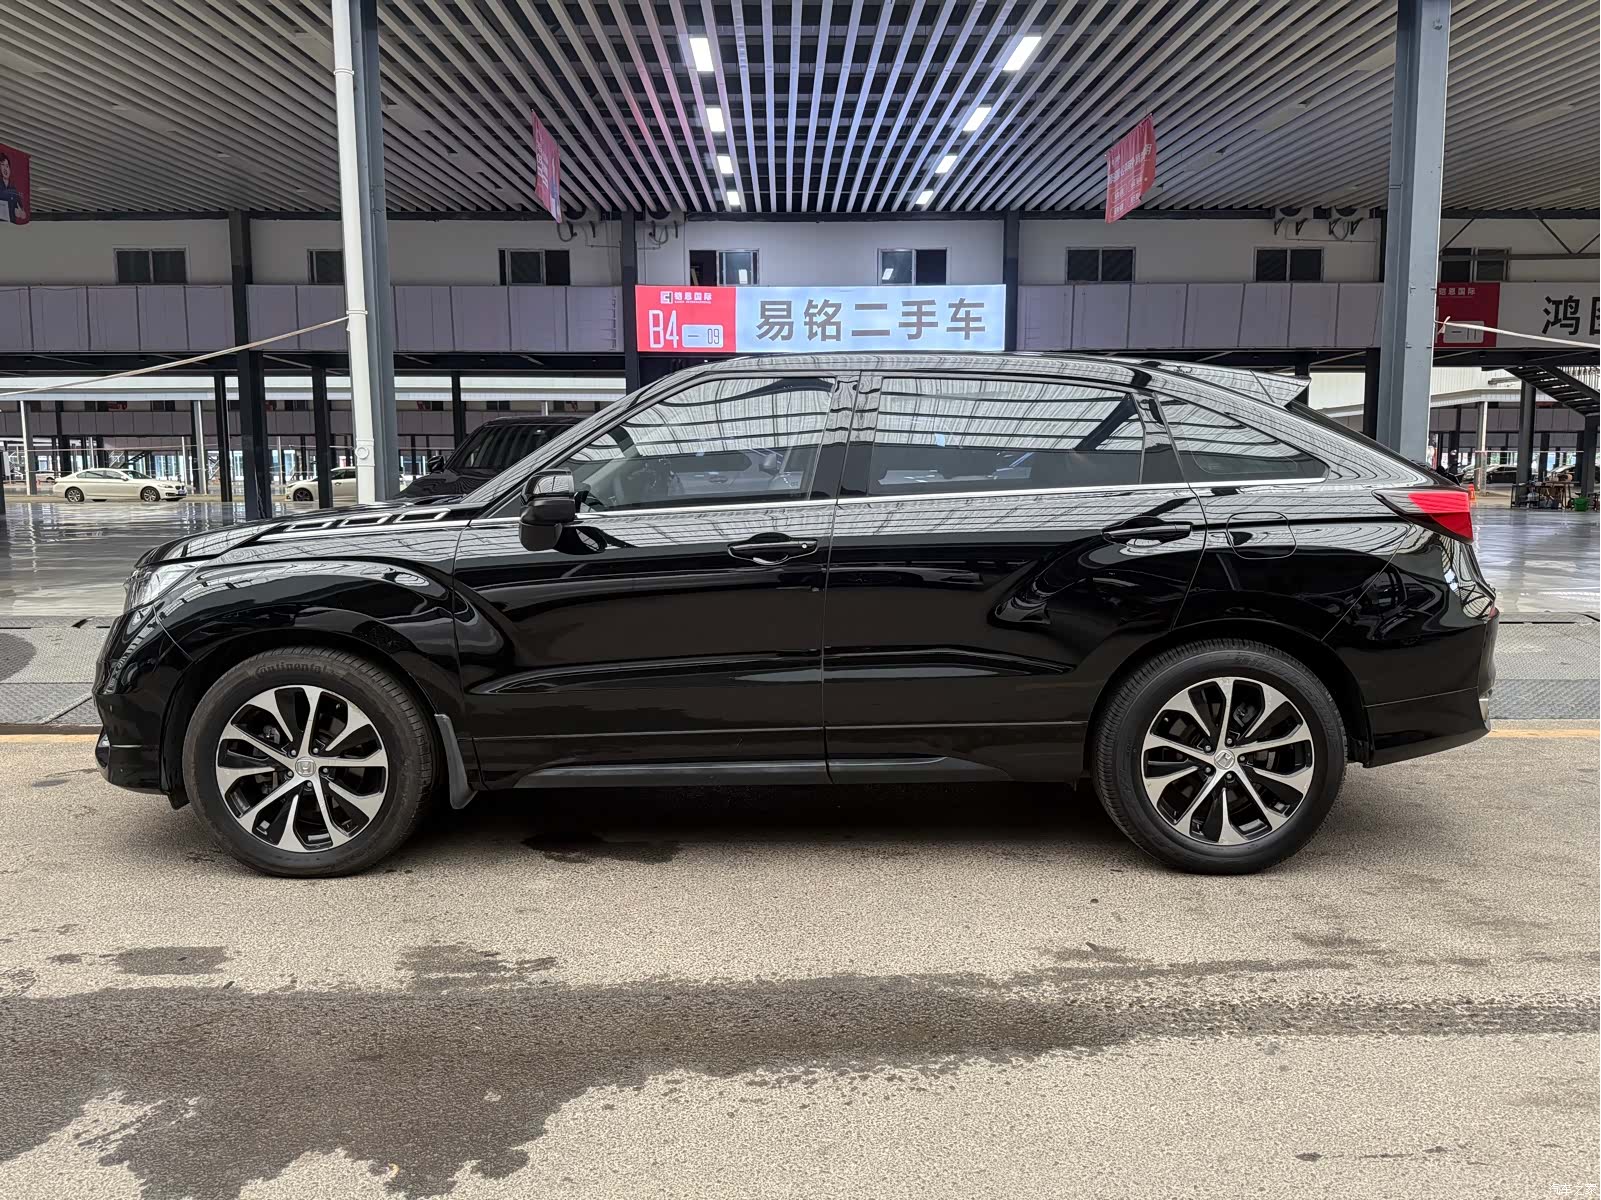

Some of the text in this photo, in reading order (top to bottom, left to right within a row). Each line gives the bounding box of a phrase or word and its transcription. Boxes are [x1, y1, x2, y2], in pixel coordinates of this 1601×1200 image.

[648, 309, 680, 349] B4
[707, 328, 720, 345] 09
[756, 298, 986, 342] 易铭二手车
[1541, 295, 1600, 336] 鸿
